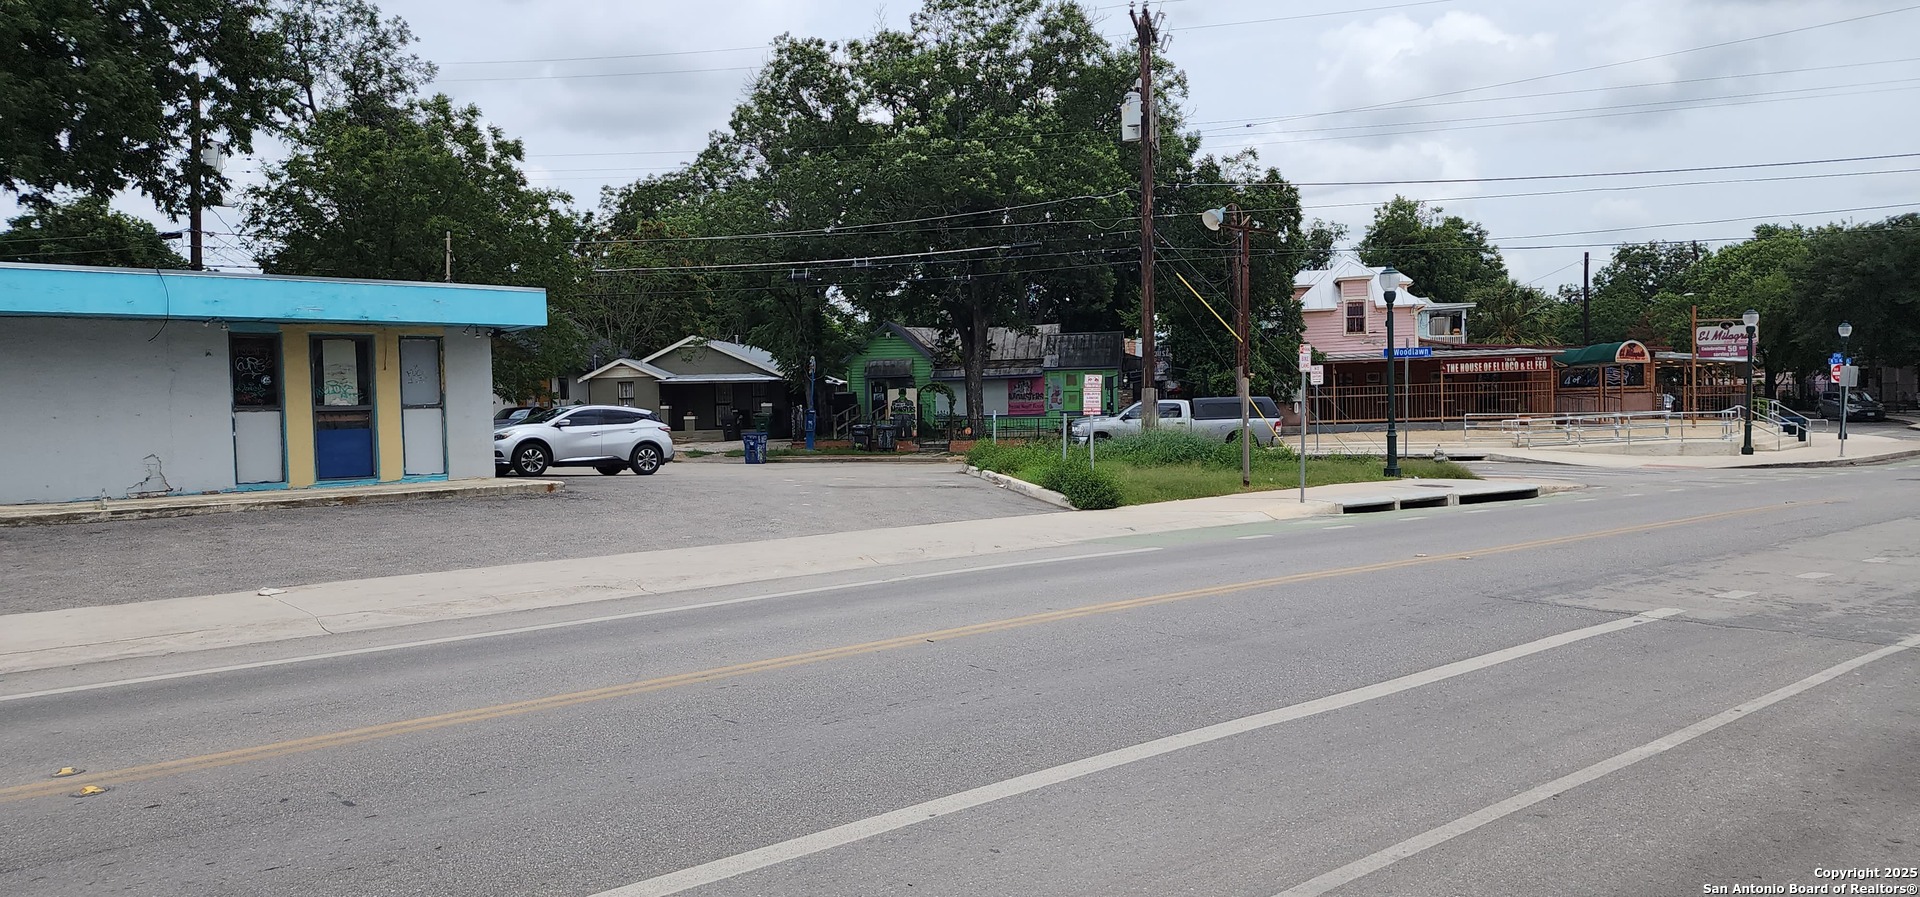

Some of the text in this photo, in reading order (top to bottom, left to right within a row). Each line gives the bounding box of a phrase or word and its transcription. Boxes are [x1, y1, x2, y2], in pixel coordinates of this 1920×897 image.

[1698, 330, 1710, 340] El
[1446, 364, 1458, 372] THE
[1460, 363, 1482, 372] HOUSE
[1484, 362, 1492, 371] OF
[1493, 362, 1500, 370] EL
[1502, 361, 1518, 370] LOCO
[1526, 360, 1534, 370] EL
[1535, 360, 1547, 370] FEO
